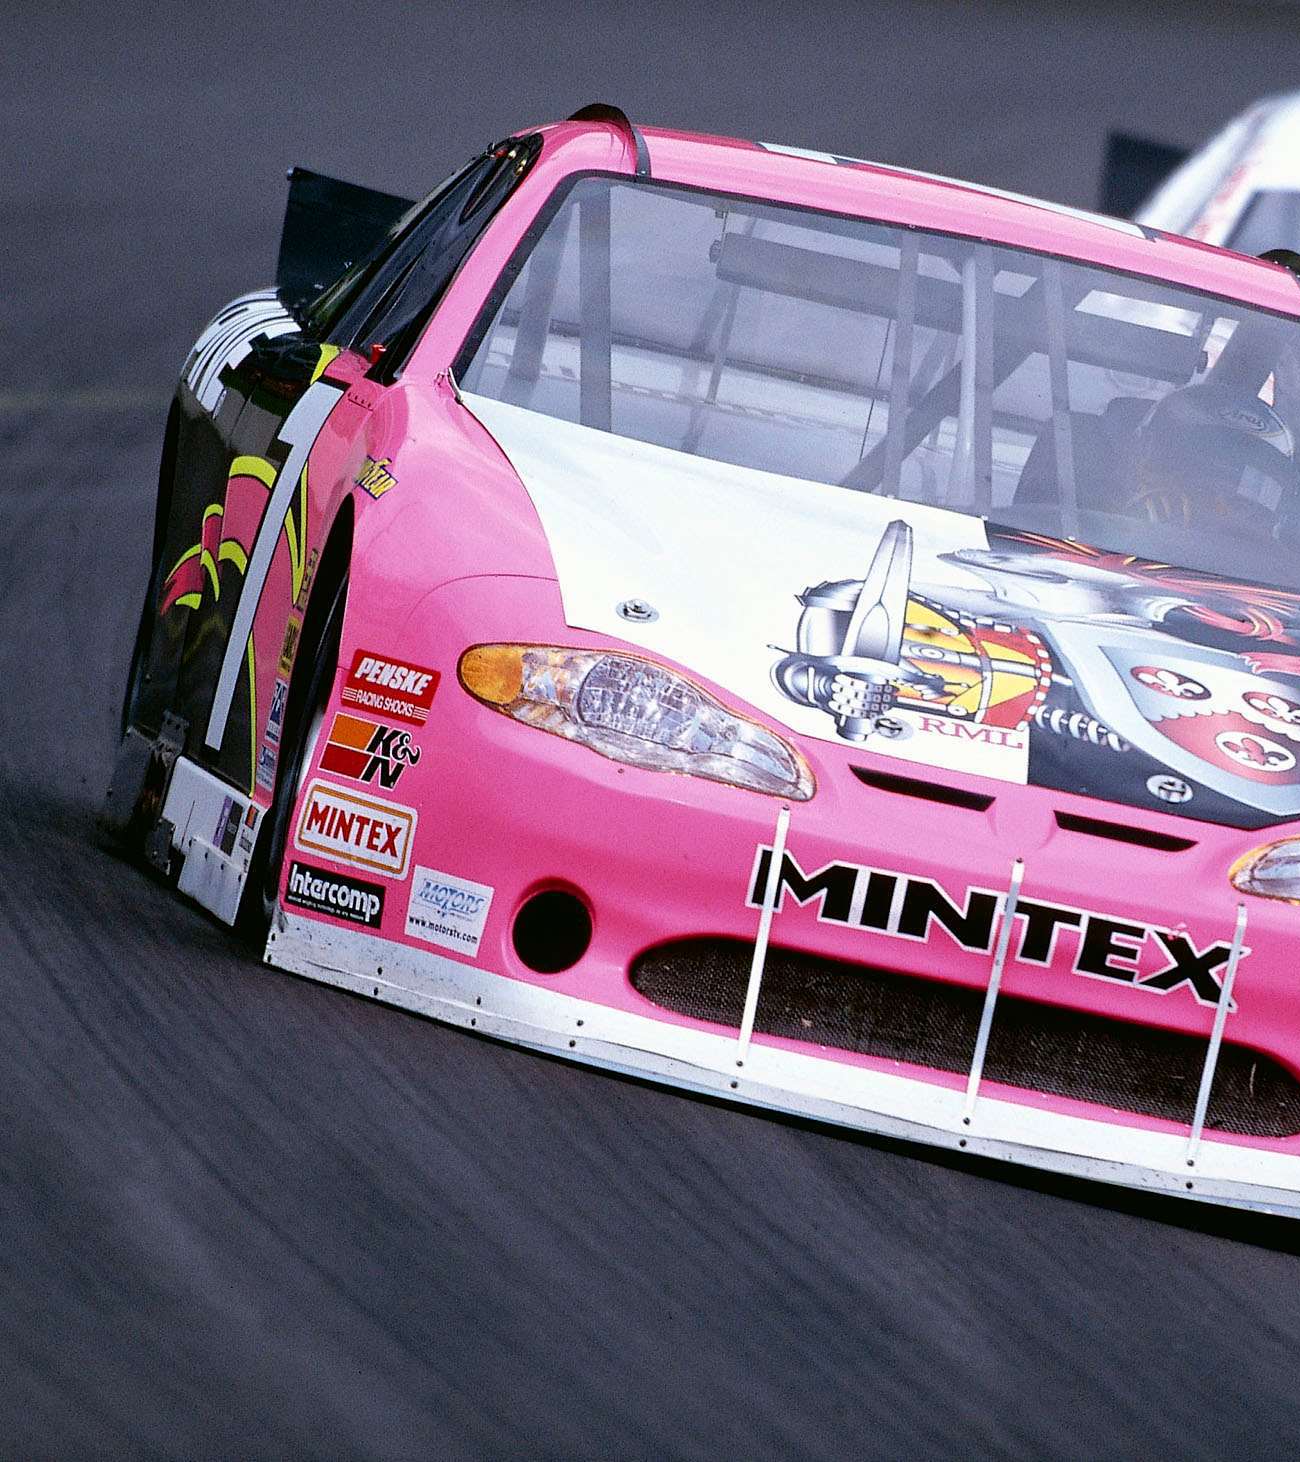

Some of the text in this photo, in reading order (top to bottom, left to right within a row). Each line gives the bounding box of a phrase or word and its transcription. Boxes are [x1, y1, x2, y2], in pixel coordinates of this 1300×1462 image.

[355, 657, 433, 695] PENSKE
[356, 690, 414, 717] RACING SHOCKS
[919, 716, 1023, 749] RML
[305, 801, 402, 858] MINTEX
[419, 879, 485, 914] MOTORS
[748, 846, 1249, 1010] MINTEX
